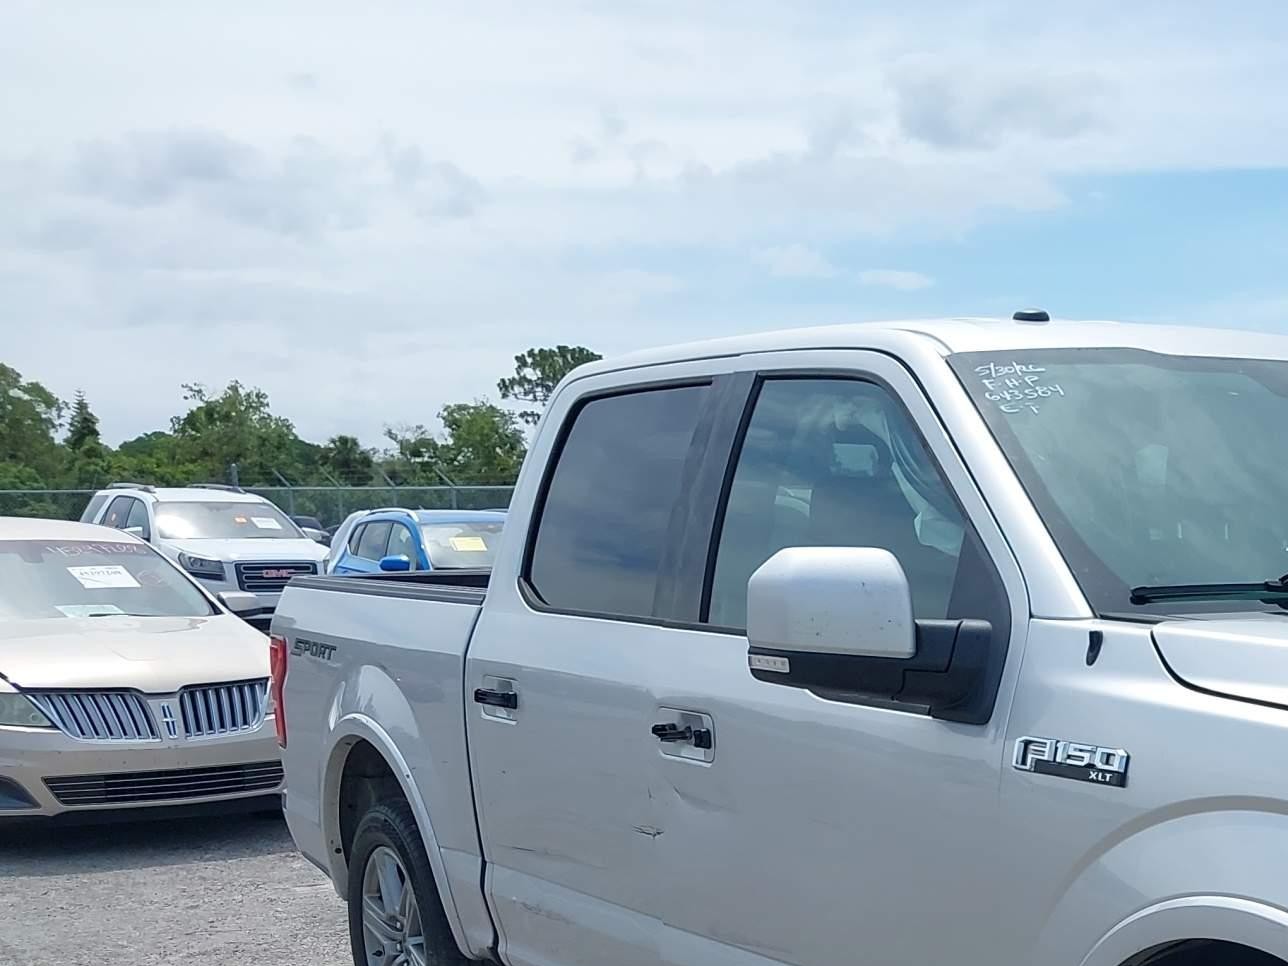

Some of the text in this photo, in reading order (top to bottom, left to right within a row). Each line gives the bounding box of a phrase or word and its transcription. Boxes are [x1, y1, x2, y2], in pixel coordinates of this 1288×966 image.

[985, 384, 1065, 400] 643584
[291, 638, 337, 660] SPORT
[1088, 770, 1113, 783] XLT
